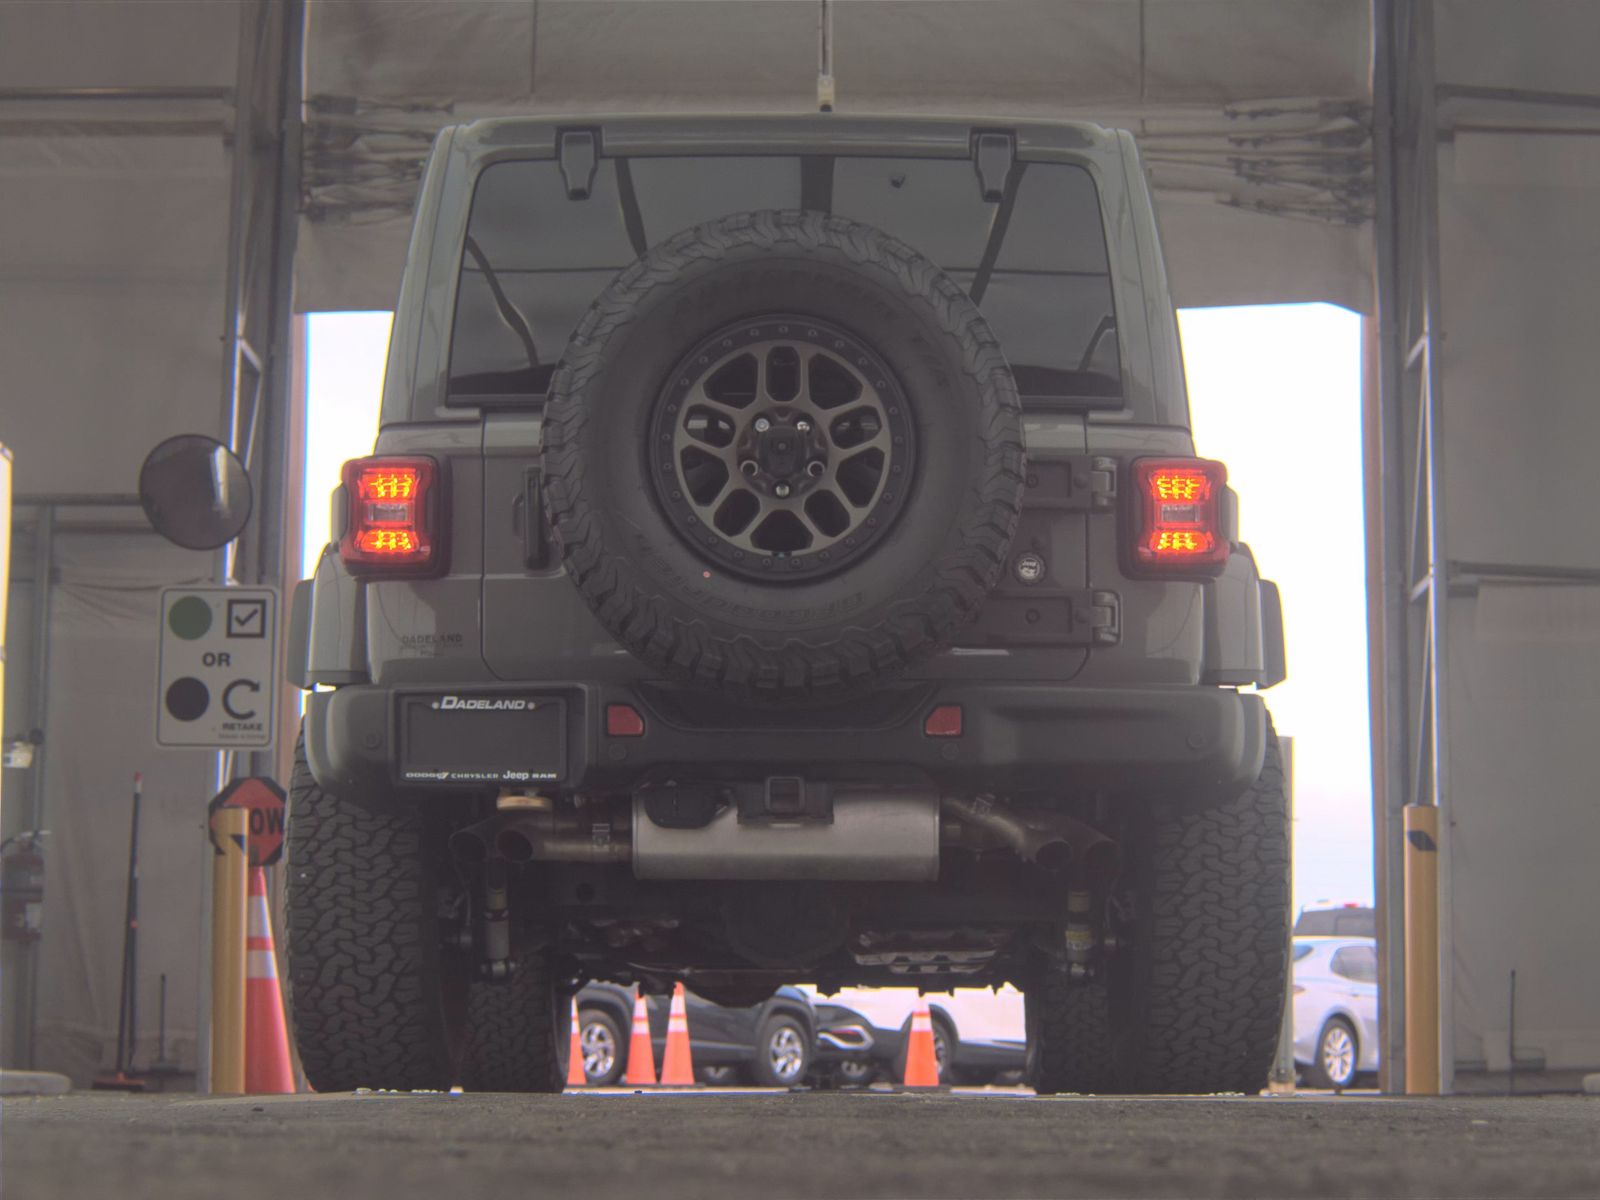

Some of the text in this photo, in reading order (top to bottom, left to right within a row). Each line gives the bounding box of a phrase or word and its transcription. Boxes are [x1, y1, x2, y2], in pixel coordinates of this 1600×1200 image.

[401, 634, 463, 644] DADELAND
[202, 652, 231, 667] OR
[440, 696, 526, 710] DADELAND
[222, 722, 263, 731] RETAKE
[502, 770, 529, 781] Jeep
[250, 807, 284, 836] OW
